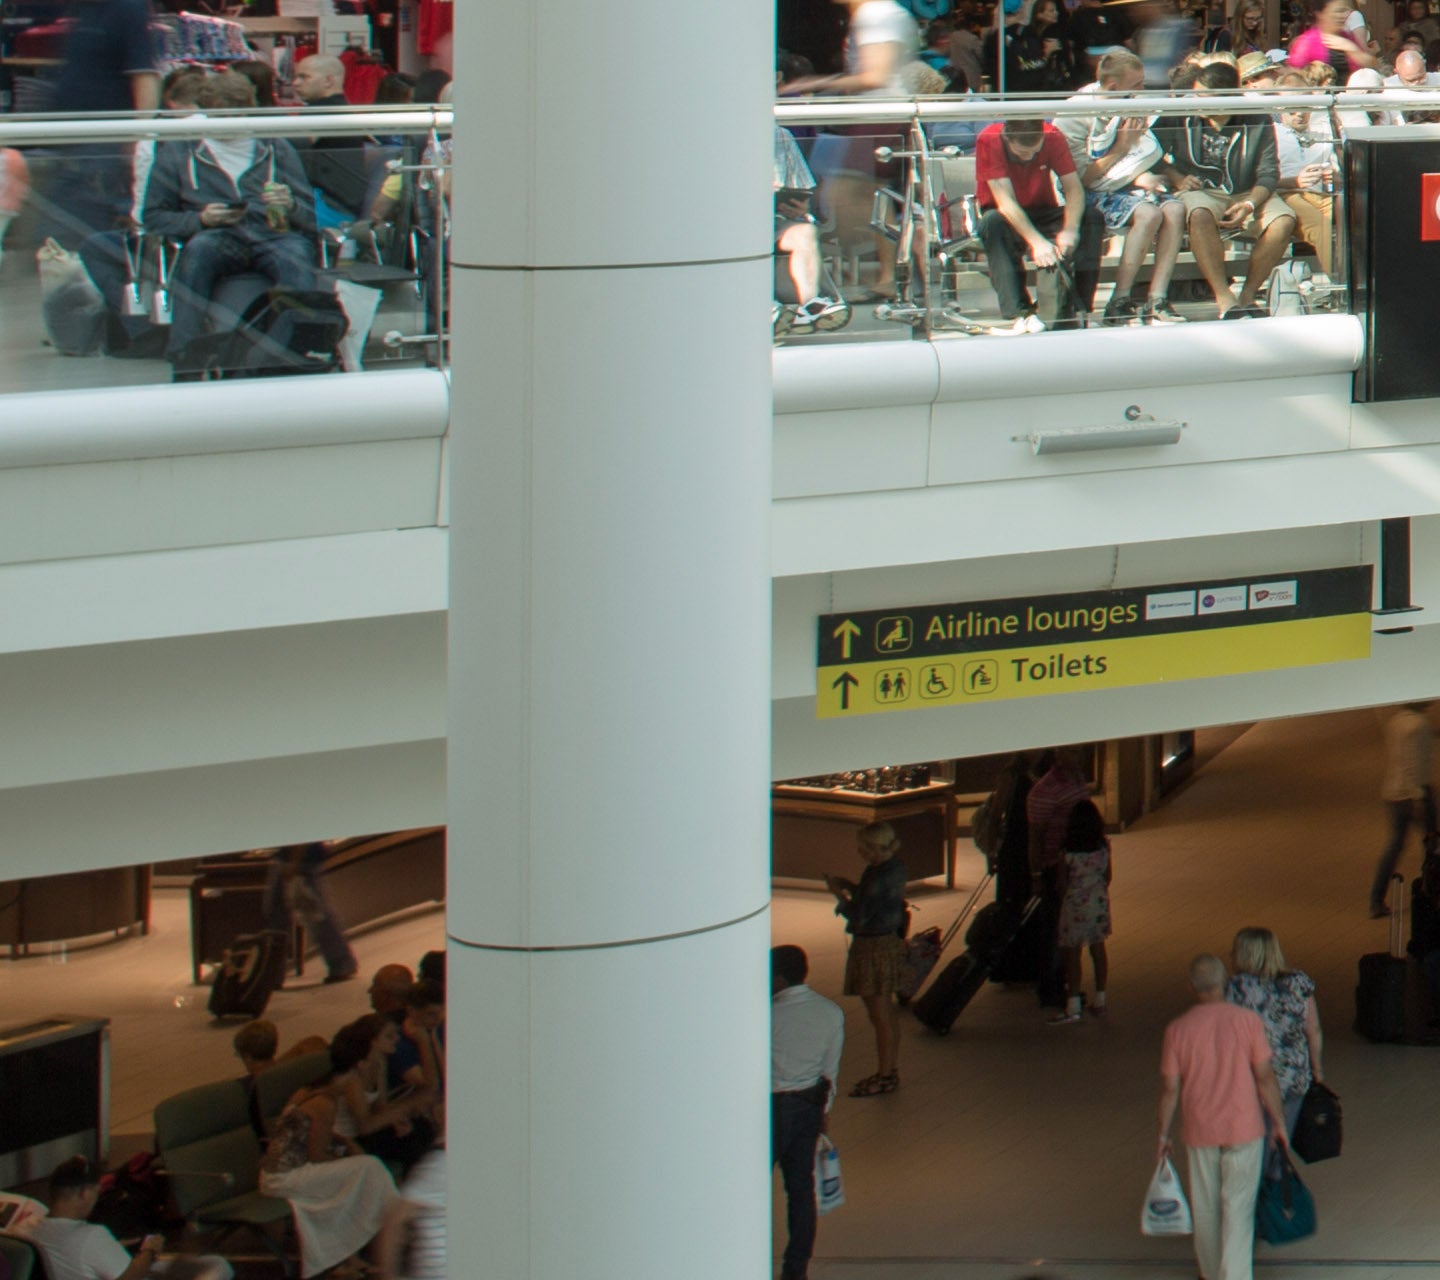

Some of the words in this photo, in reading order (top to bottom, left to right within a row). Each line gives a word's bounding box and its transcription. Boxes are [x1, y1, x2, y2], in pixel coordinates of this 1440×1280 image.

[925, 605, 1019, 642] Airline
[1026, 599, 1139, 639] lounges
[1011, 652, 1108, 685] Toilets
